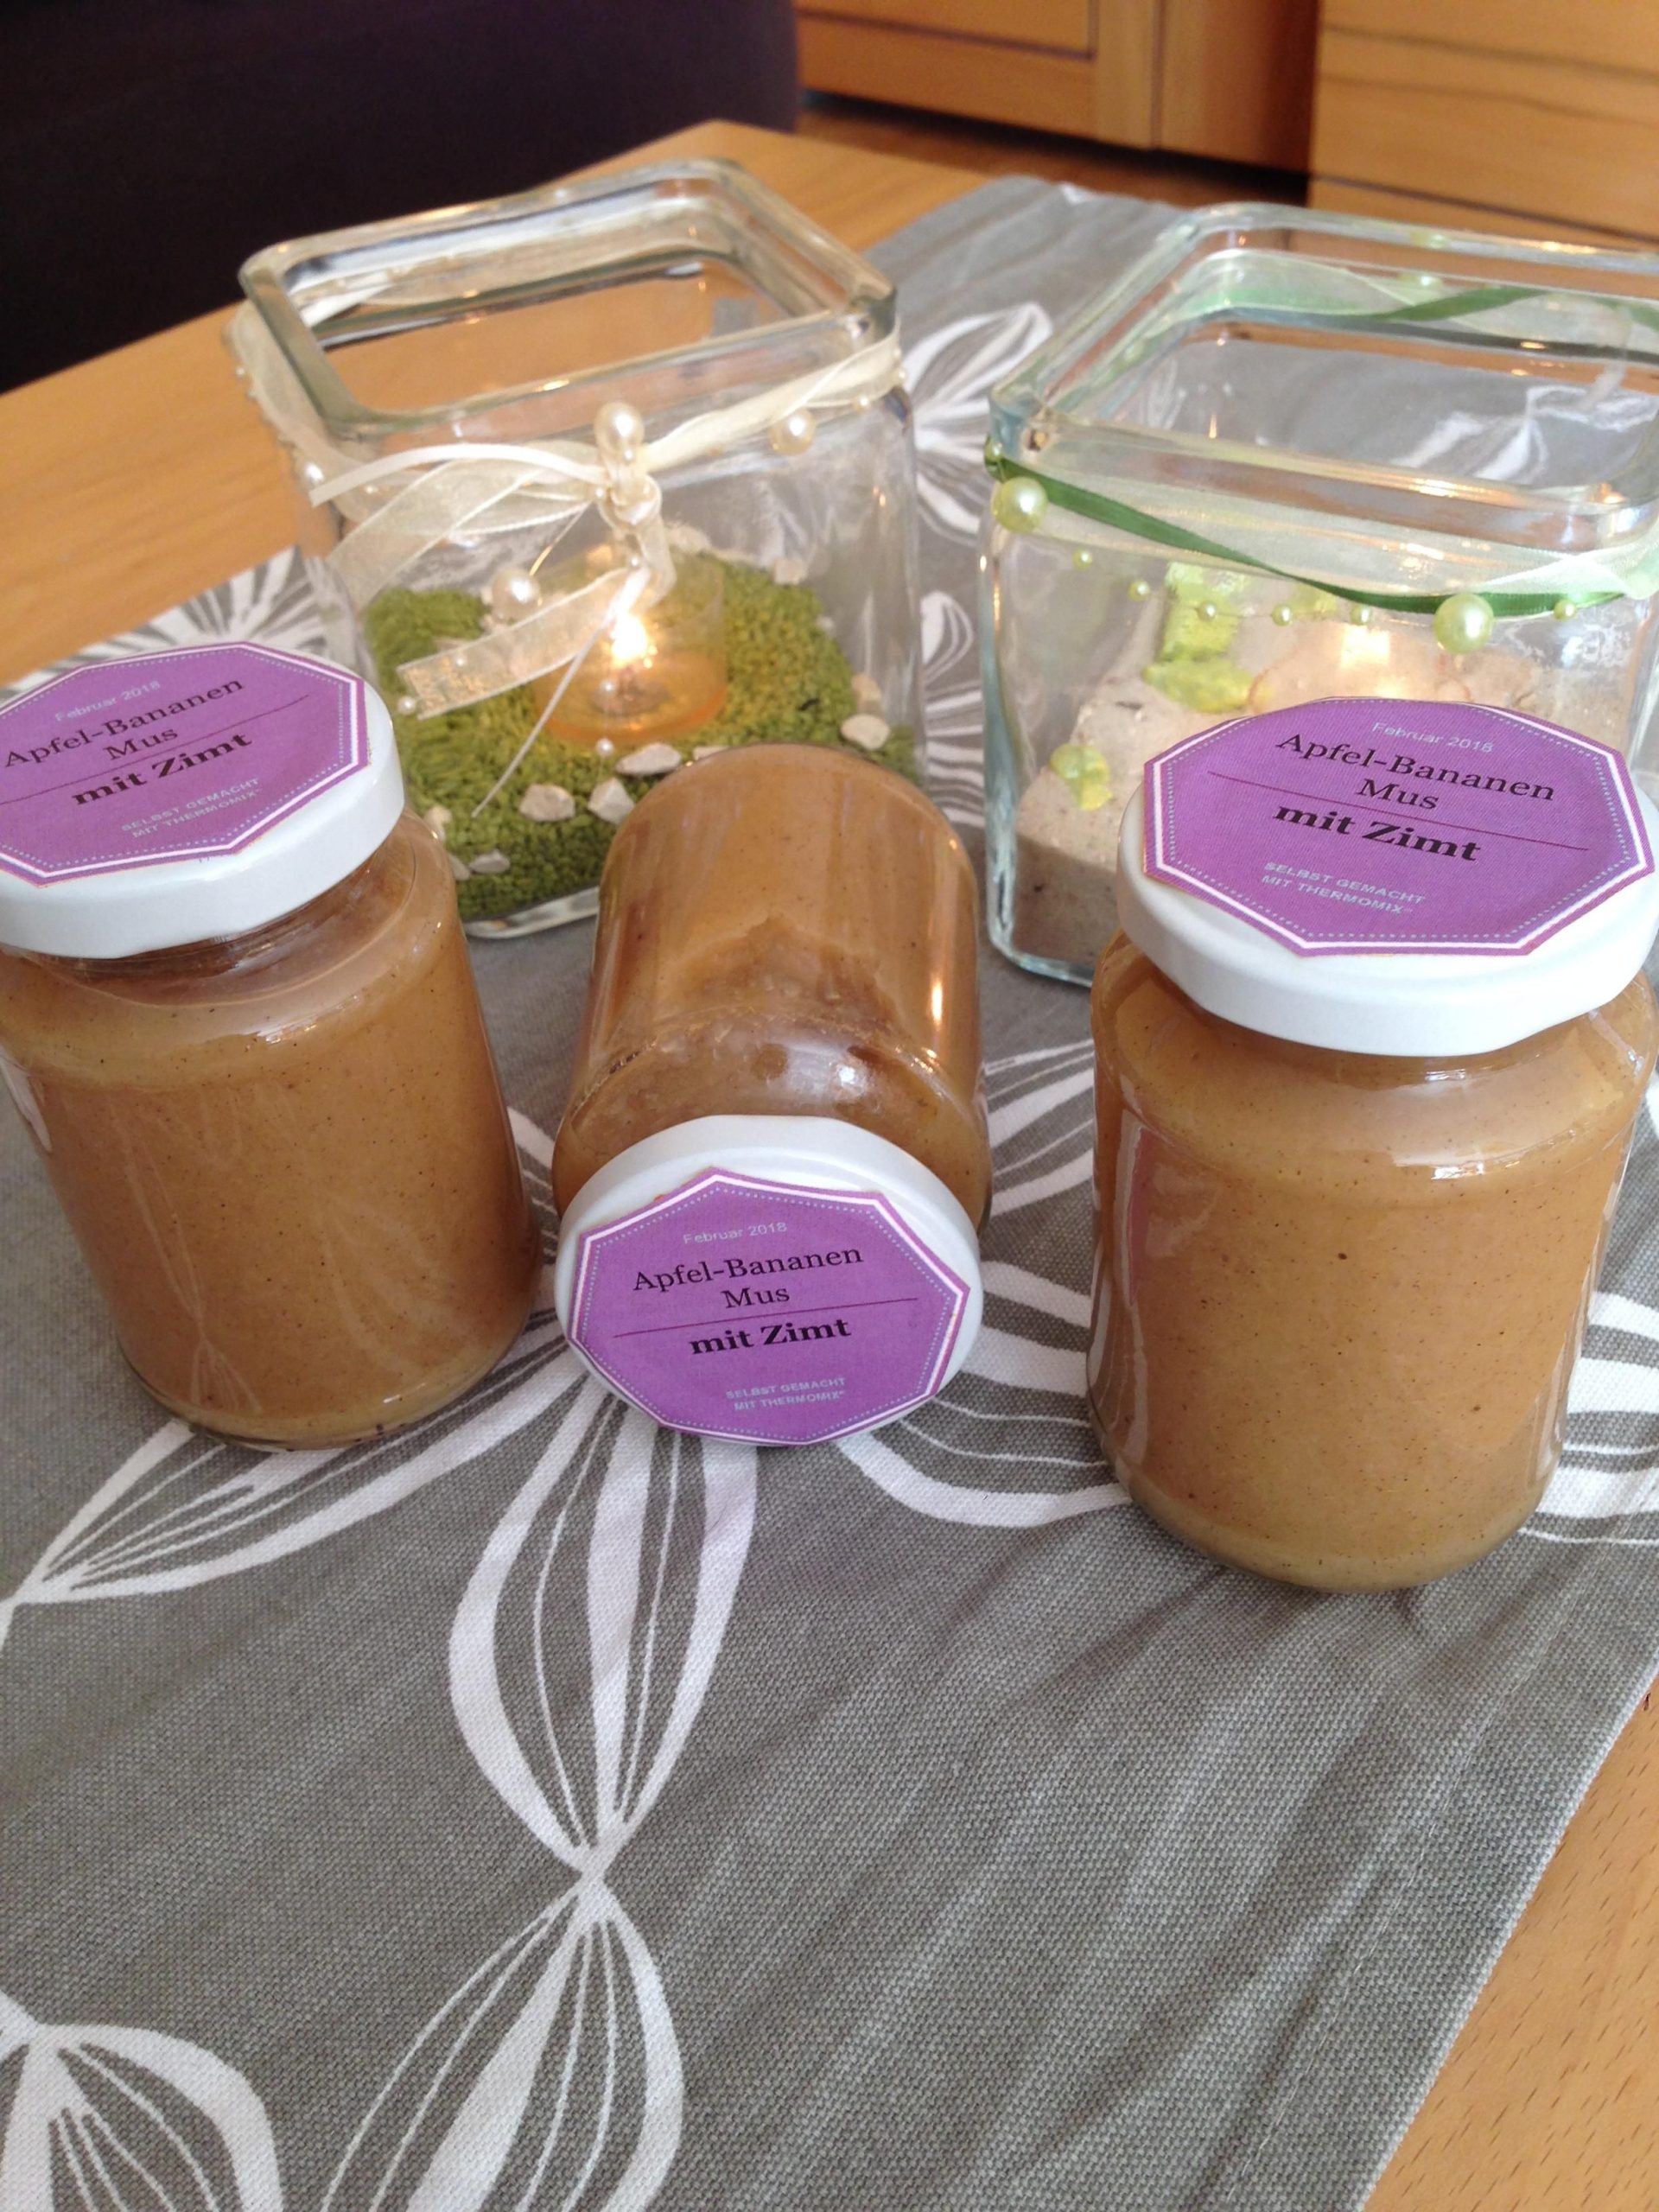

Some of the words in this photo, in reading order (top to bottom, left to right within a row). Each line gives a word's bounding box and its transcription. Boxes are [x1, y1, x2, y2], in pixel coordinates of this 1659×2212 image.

[56, 699, 117, 721] Februar
[122, 681, 160, 700] 2018
[5, 680, 243, 766] Apfel-Bananen
[1372, 722, 1442, 745] Februar
[1448, 735, 1494, 753] 2018
[105, 728, 179, 760] Mus
[73, 772, 148, 804] mit
[152, 734, 251, 779] Zimt
[1276, 734, 1555, 801] Apfel-Bananen
[122, 807, 180, 831] SELBST
[186, 778, 258, 809] GEMACHT
[1356, 779, 1439, 810] Mus
[132, 823, 159, 838] MIT
[1273, 805, 1355, 835] mit
[1363, 823, 1480, 862] Zimt
[1262, 874, 1292, 888] MIT
[1264, 862, 1332, 884] SELBST
[1336, 878, 1426, 904] GEMACHT
[683, 1228, 744, 1244] Februar
[749, 1223, 787, 1236] 2018
[633, 1248, 863, 1292] Apfel-Bananen
[722, 1288, 790, 1308] Mus
[689, 1330, 754, 1355] mit
[760, 1319, 851, 1345] Zimt
[726, 1385, 776, 1399] SELBST
[780, 1377, 845, 1393] GEMACHT
[734, 1400, 756, 1411] MIT
